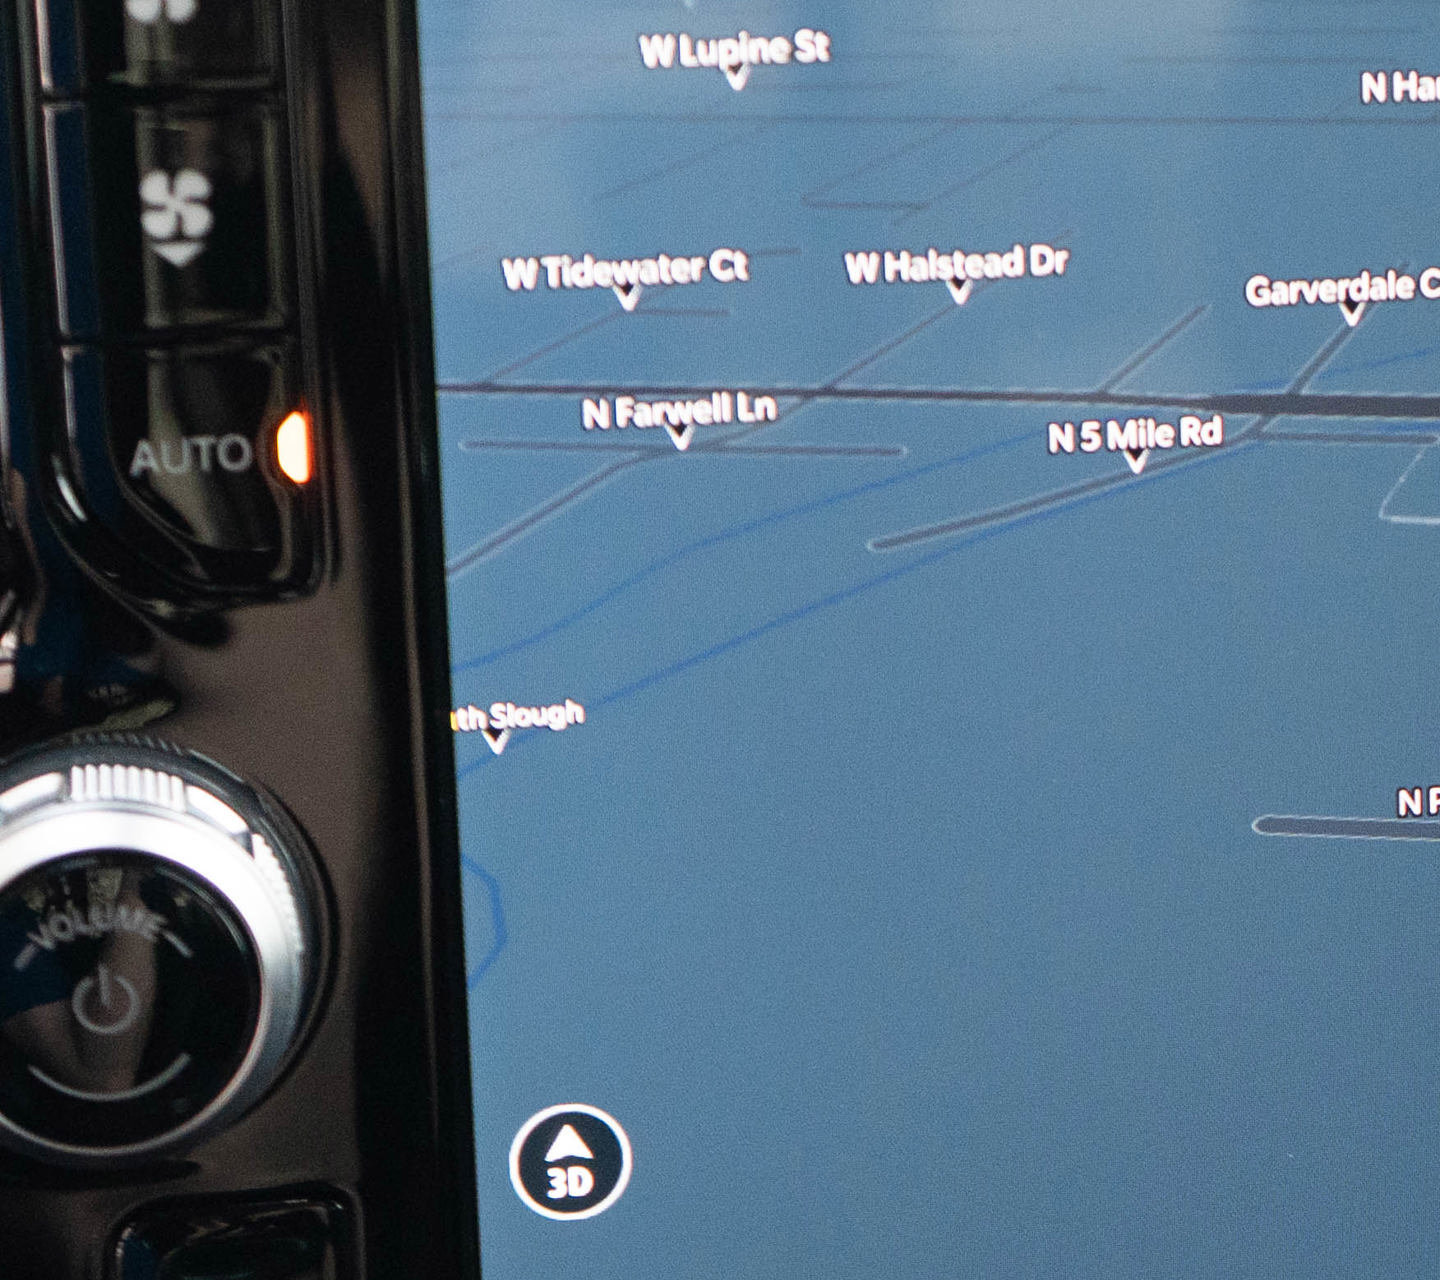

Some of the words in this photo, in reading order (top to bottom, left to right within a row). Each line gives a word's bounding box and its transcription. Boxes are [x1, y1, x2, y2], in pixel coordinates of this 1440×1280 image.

[638, 33, 676, 69] W
[678, 30, 792, 73] Lupine
[794, 28, 830, 63] St
[1361, 72, 1387, 104] N
[502, 258, 538, 292] W
[540, 252, 702, 290] Tidewater
[709, 249, 750, 283] Ct
[845, 251, 881, 285] W
[884, 246, 1023, 284] Halstead
[1030, 244, 1069, 278] Dr
[1245, 268, 1414, 308] Garverdale
[582, 398, 611, 430] N
[614, 392, 732, 428] Farwell
[738, 392, 778, 423] Ln
[1048, 422, 1074, 454] N
[1079, 421, 1101, 452] 5
[1106, 418, 1174, 452] Mile
[1180, 414, 1223, 447] Rd
[129, 433, 254, 478] AUTO
[489, 698, 585, 731] Slough
[1397, 788, 1422, 817] N
[546, 1166, 594, 1200] 3D
